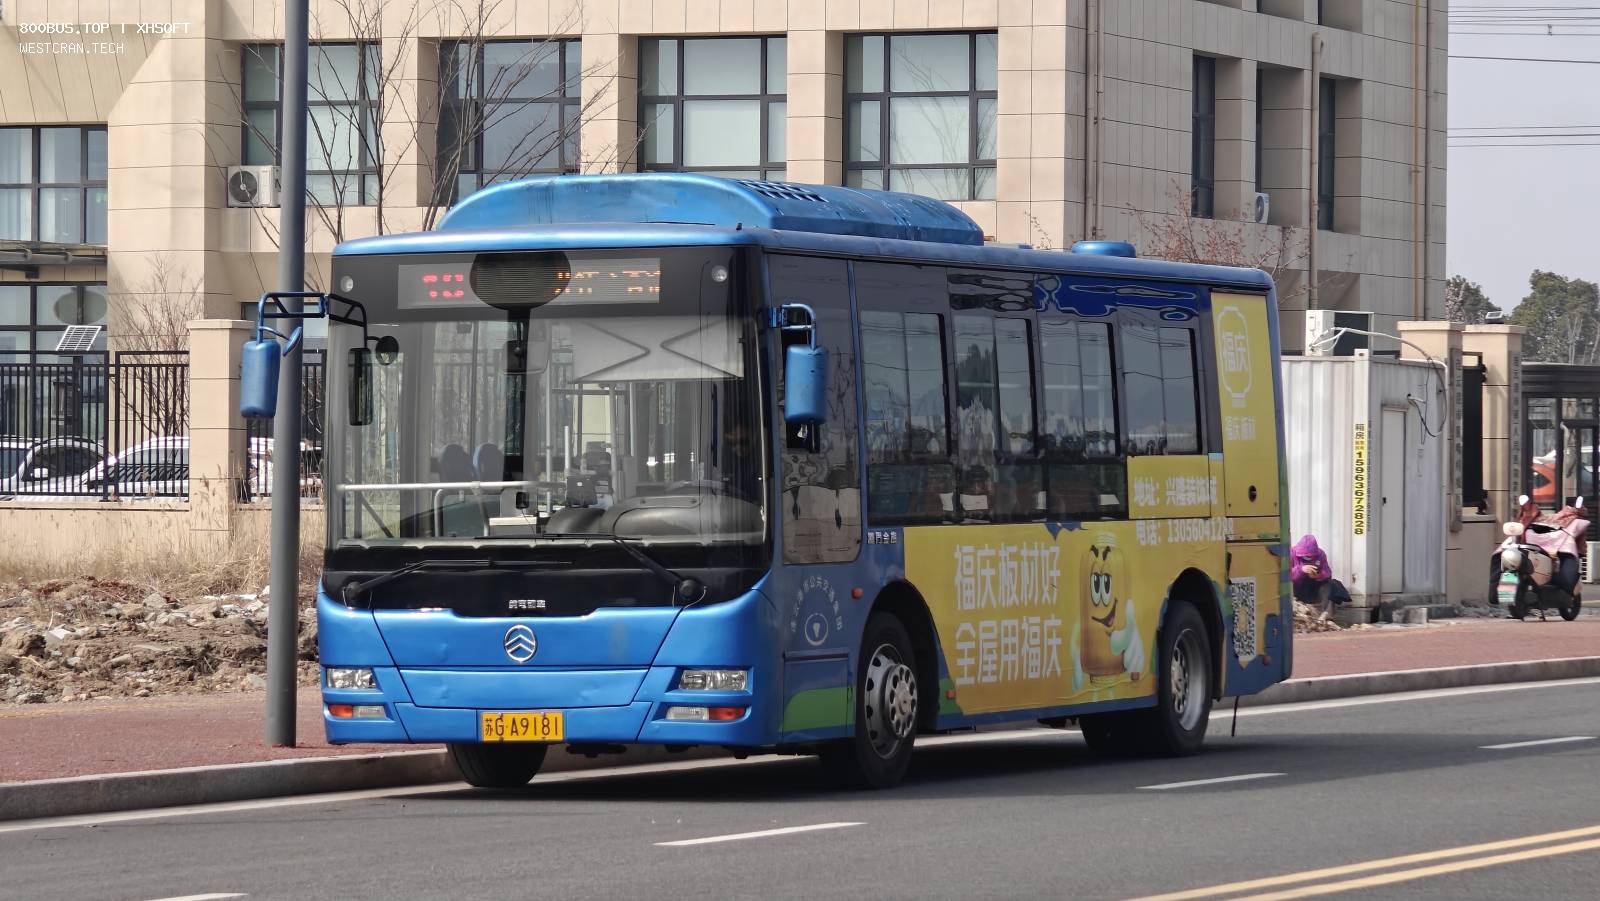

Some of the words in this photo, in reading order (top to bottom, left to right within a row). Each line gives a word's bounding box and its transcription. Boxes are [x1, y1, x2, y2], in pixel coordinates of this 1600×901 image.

[1354, 451, 1364, 535] 15963672828
[954, 542, 1061, 610] 福庆板材好
[955, 614, 1063, 686] 全屋用福庆
